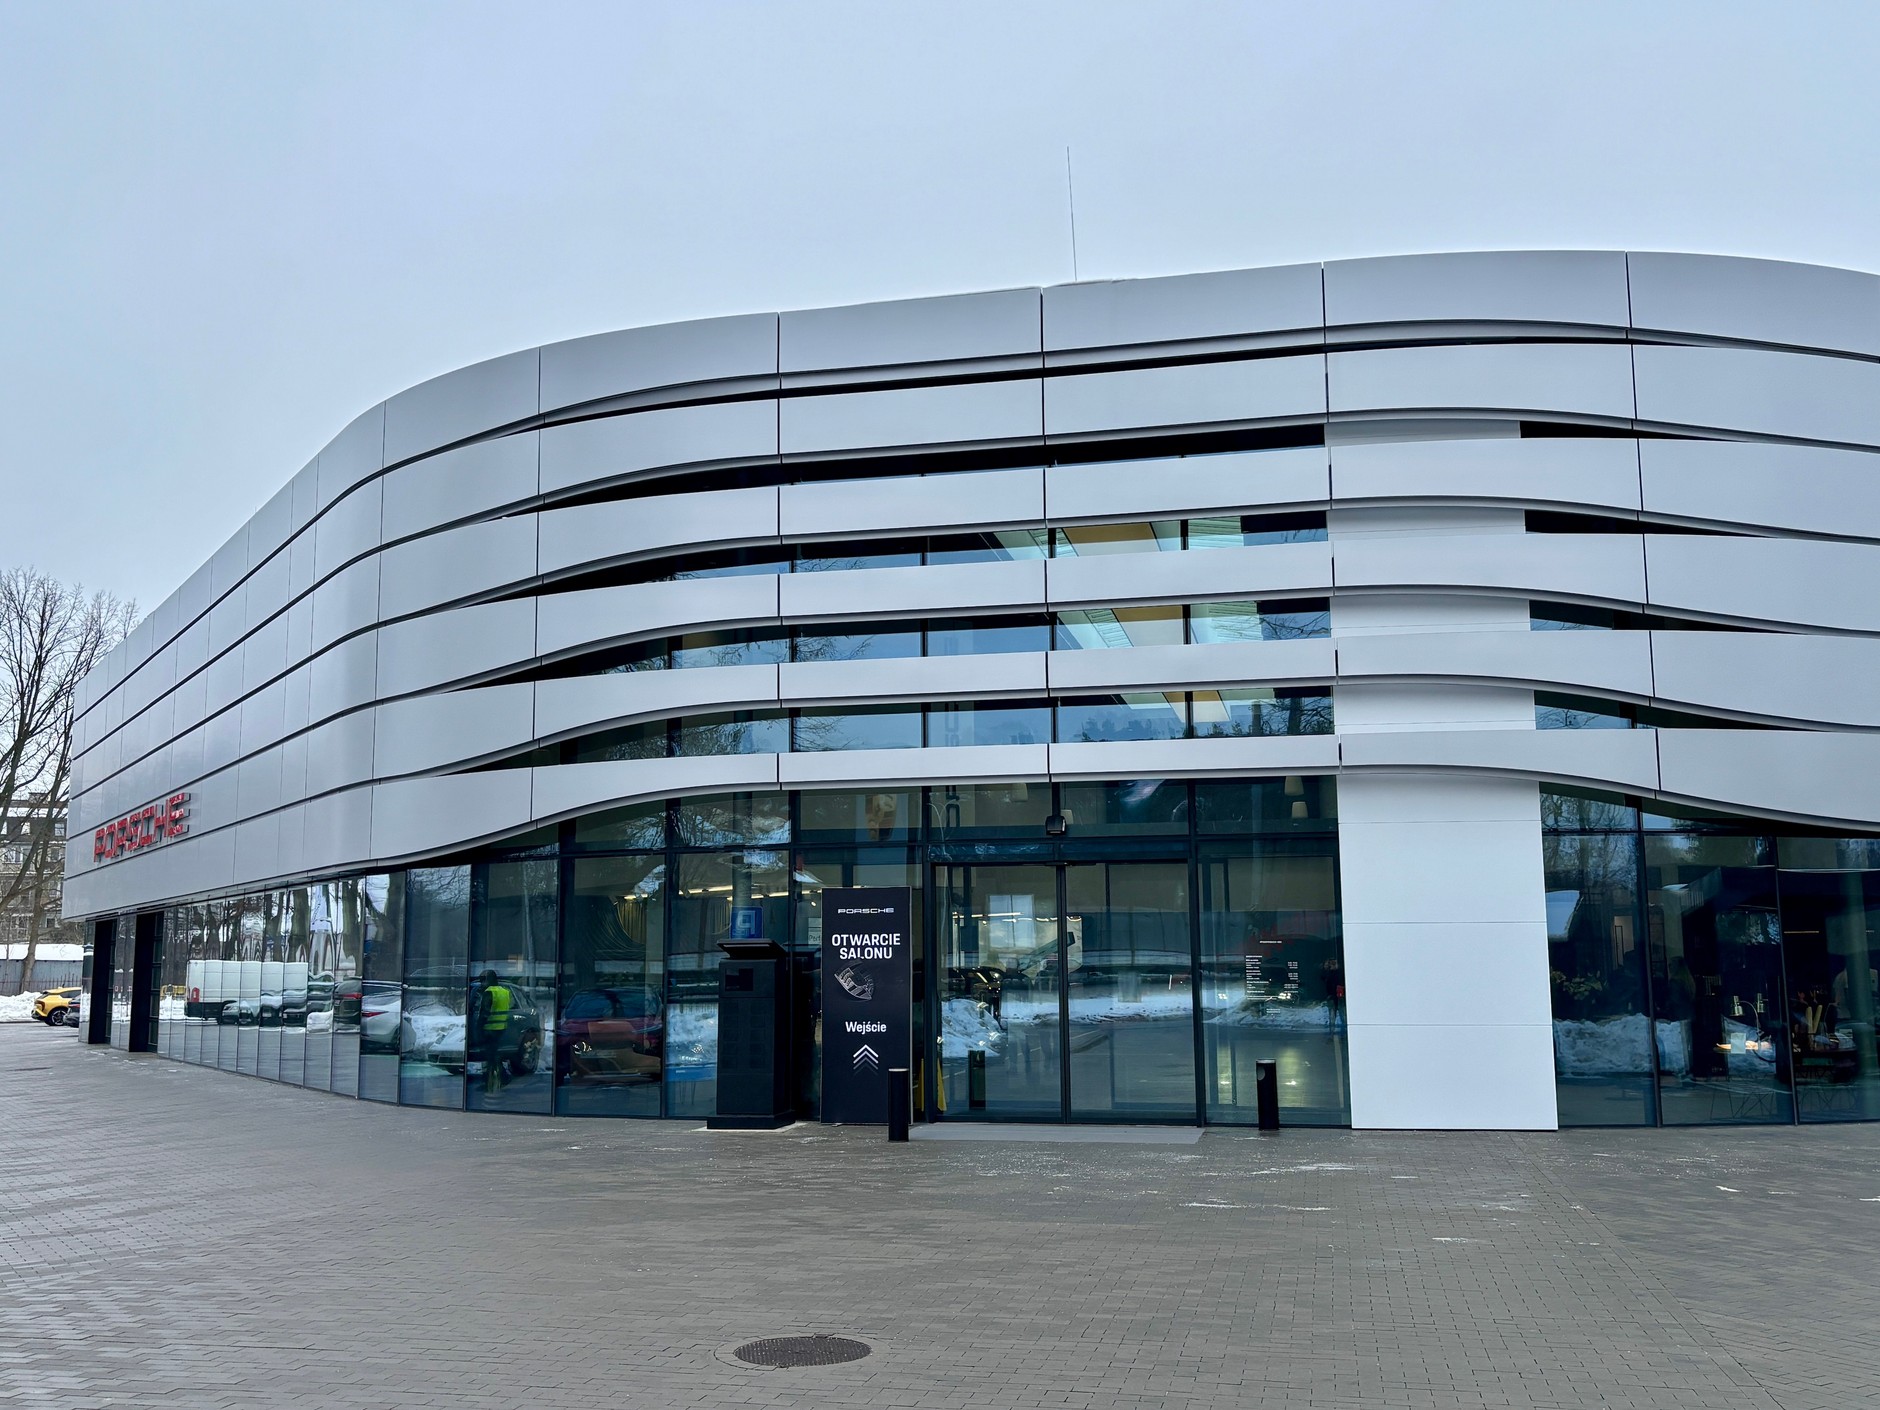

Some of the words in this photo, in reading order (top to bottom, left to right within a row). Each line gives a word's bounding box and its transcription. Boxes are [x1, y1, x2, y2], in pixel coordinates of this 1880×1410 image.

[94, 793, 190, 863] PORSCHE
[831, 933, 901, 946] OTWARCIE
[840, 947, 892, 959] SALONU
[845, 1021, 887, 1035] Wejście
